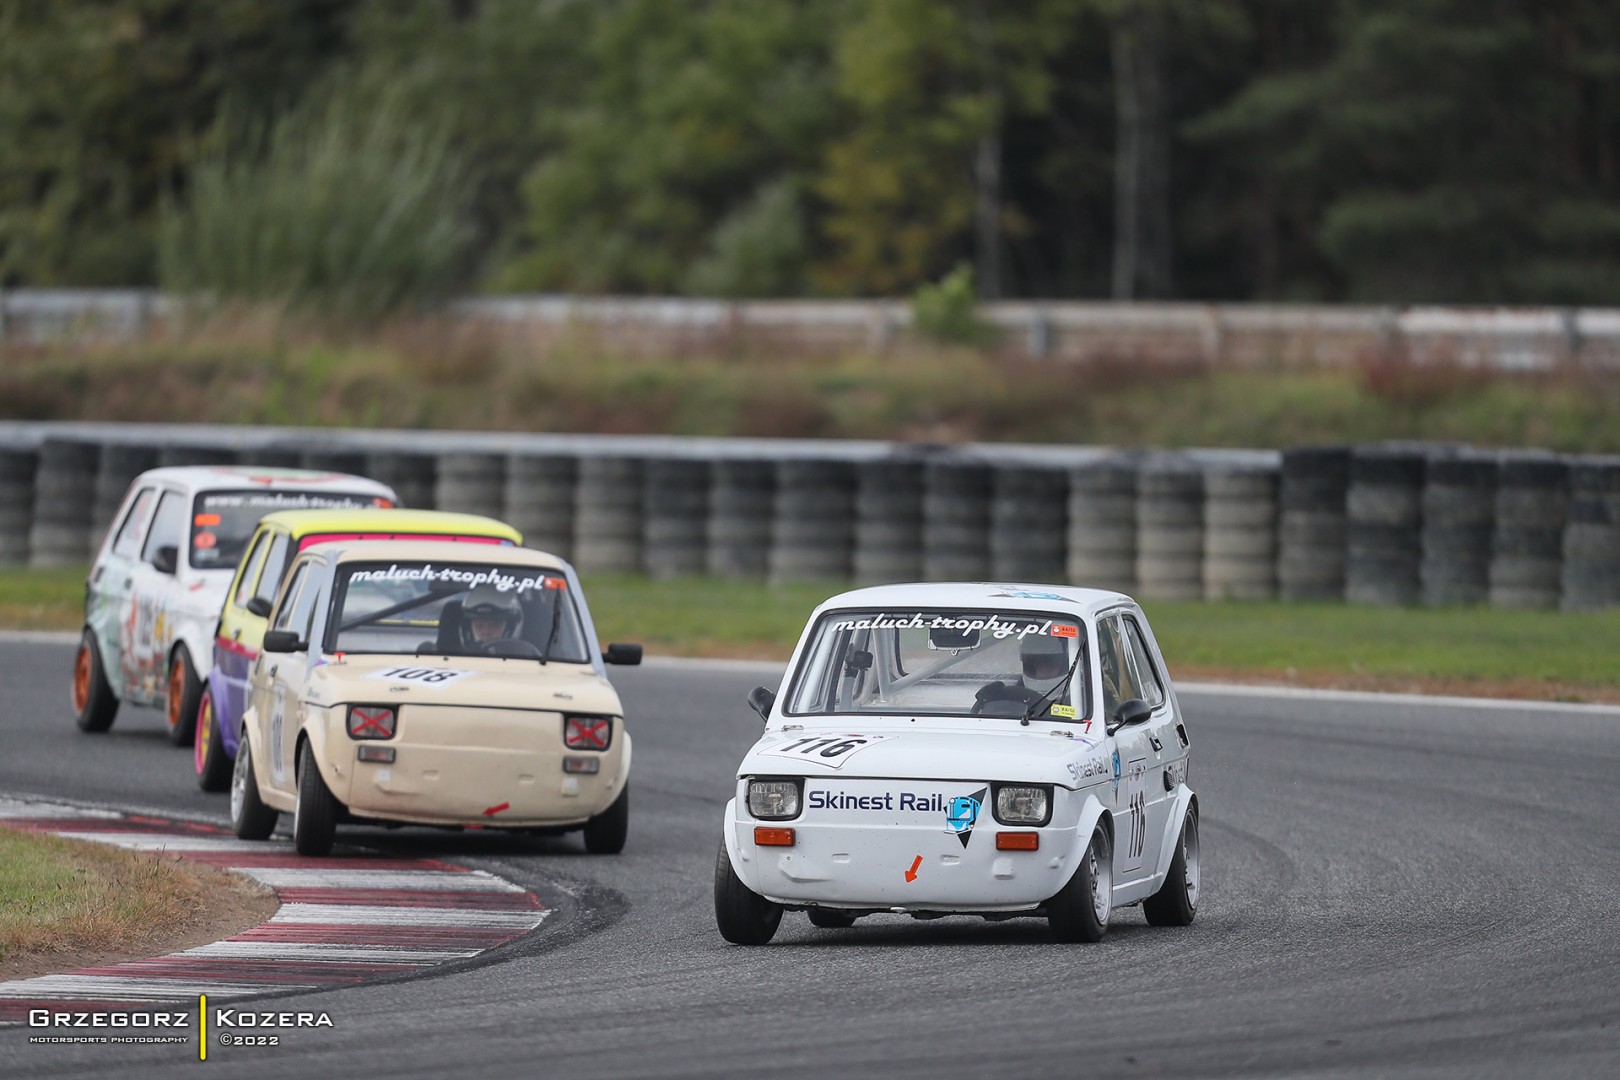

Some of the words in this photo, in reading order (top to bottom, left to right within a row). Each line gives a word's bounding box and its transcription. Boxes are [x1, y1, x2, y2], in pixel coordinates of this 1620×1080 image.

[349, 564, 545, 593] maluch-trophy.pl
[832, 612, 1053, 640] maluch-trophy.pl
[383, 667, 458, 683] 108
[780, 736, 868, 758] 116
[808, 790, 893, 811] Skinest
[899, 792, 943, 812] Rail
[1128, 790, 1146, 859] 116
